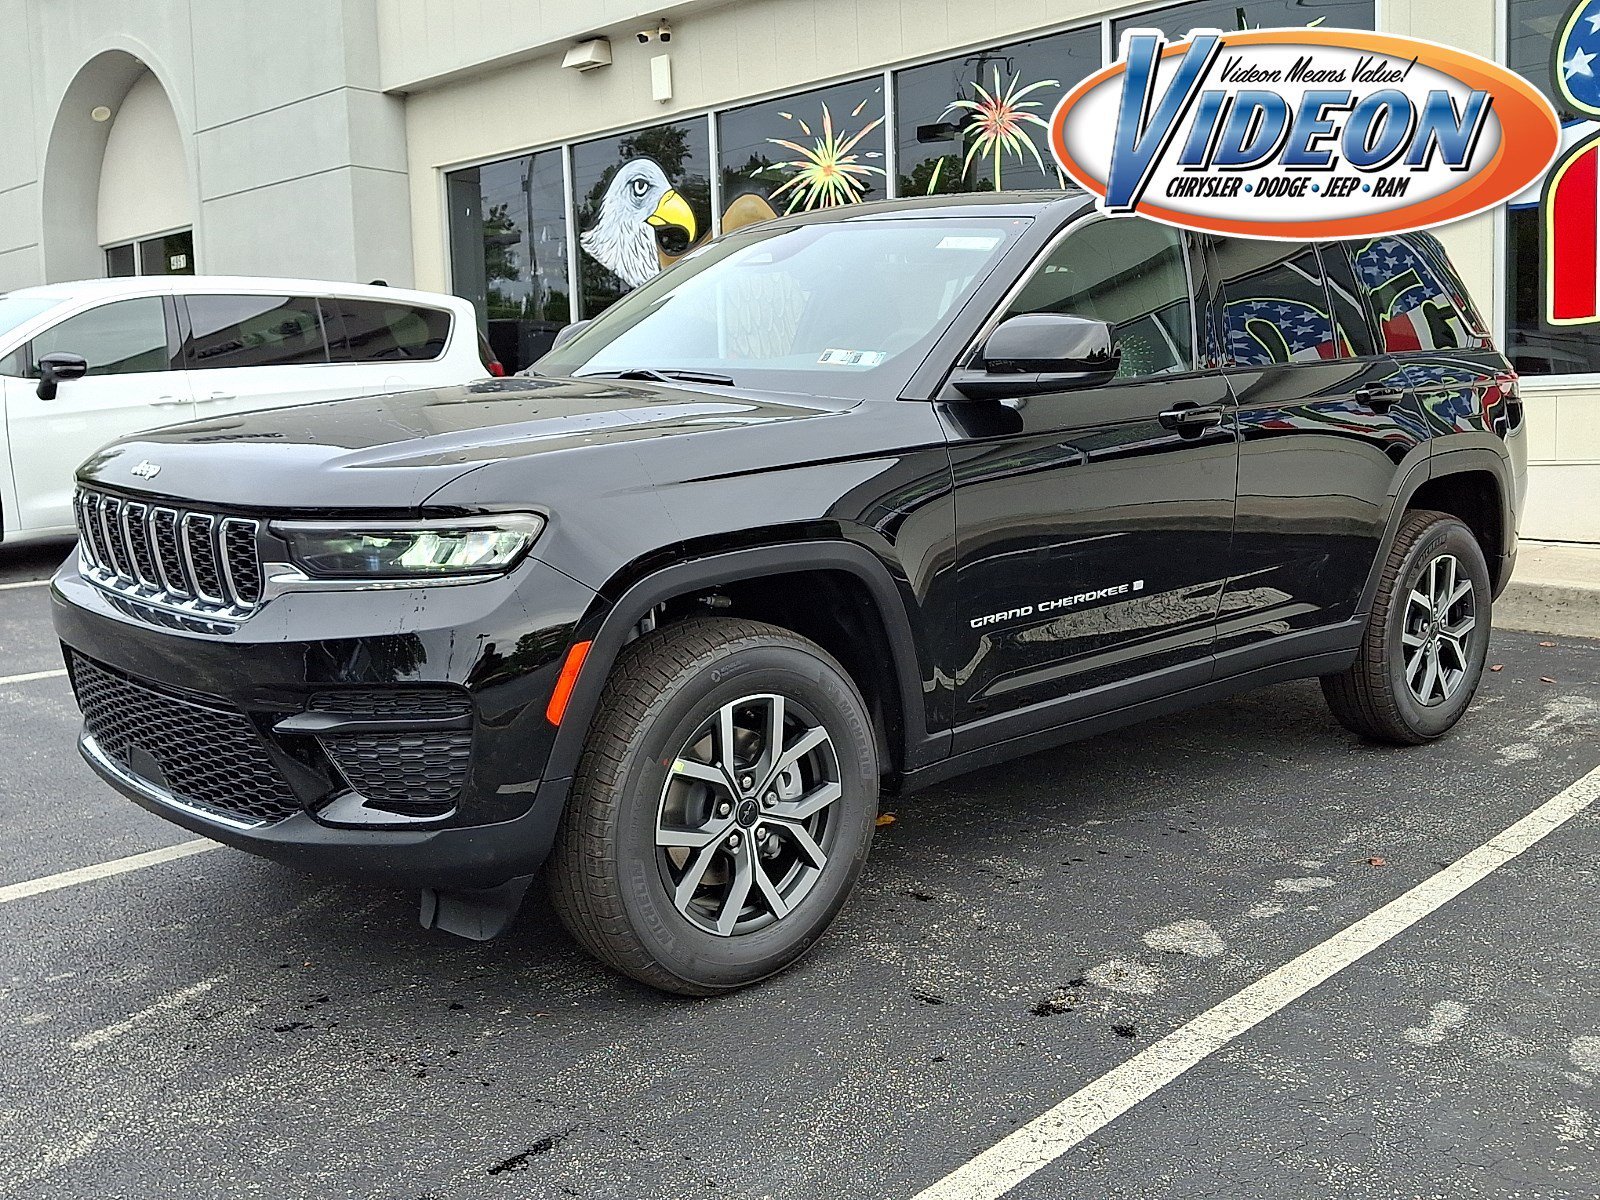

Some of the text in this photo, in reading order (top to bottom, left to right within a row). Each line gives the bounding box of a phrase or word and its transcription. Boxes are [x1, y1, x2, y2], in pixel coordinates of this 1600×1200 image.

[970, 583, 1129, 628] GRAND CHEROKEE
[839, 700, 872, 776] MICHELIN
